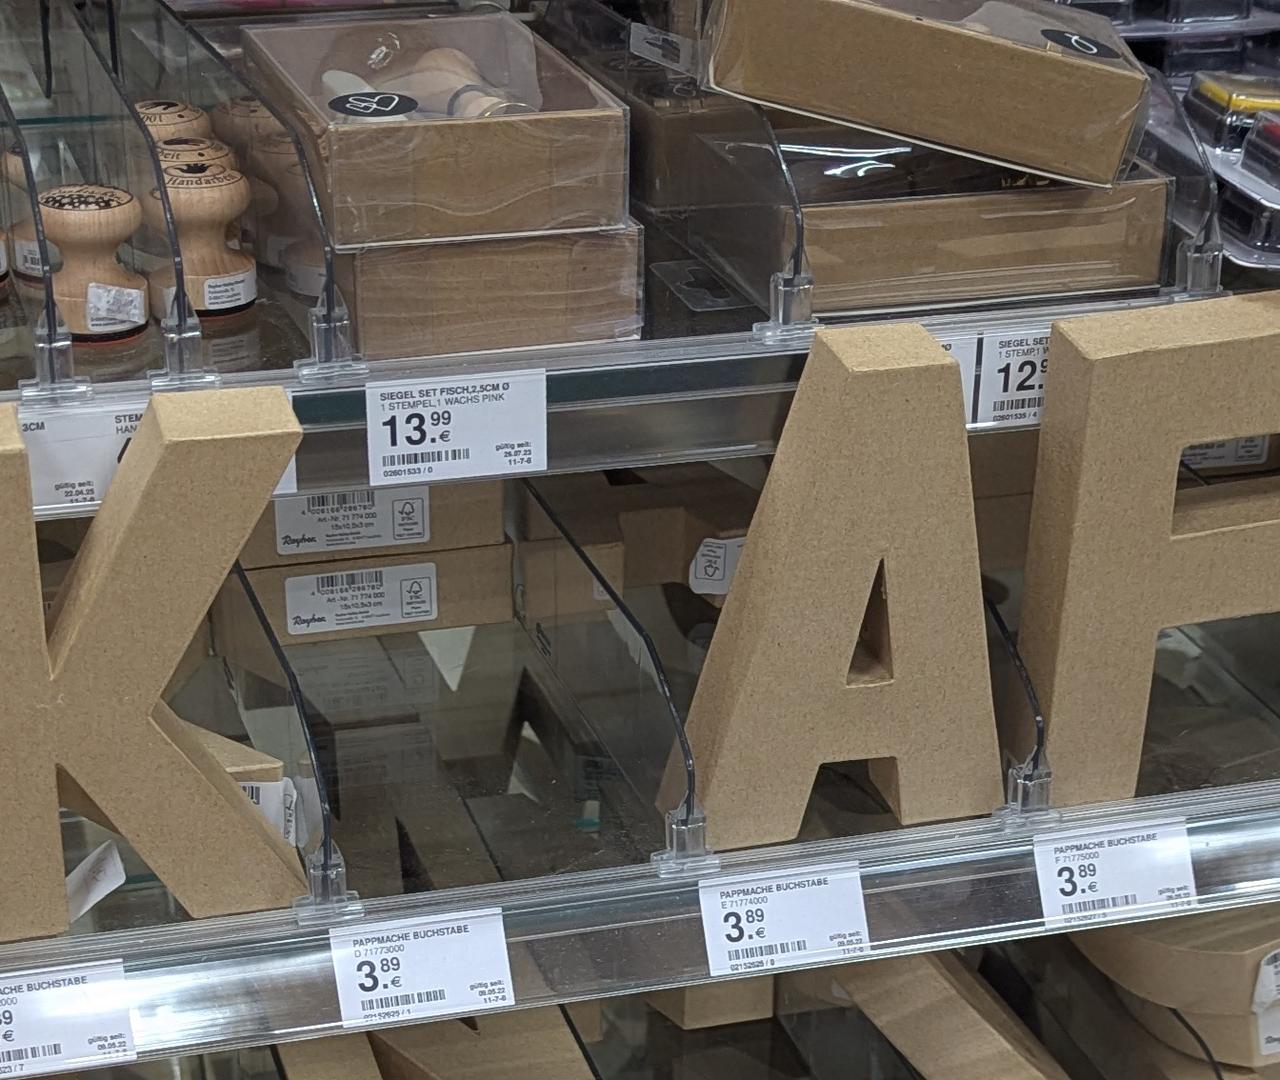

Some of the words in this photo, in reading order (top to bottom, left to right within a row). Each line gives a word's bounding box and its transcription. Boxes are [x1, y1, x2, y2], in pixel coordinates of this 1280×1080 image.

[998, 339, 1029, 349] SIEGEL
[380, 390, 416, 401] SIEGEL
[418, 388, 438, 399] SET
[444, 395, 480, 406] WACHS
[482, 392, 505, 402] PINK
[1054, 840, 1106, 855] PAPPMACHE
[1107, 832, 1158, 849] BUCHSTABE
[720, 884, 774, 900] PAPPMACHE
[776, 876, 829, 893] BUCHSTABE
[352, 932, 411, 948] PAPPMACHE
[412, 924, 470, 940] BUCHSTABE
[26, 976, 89, 993] BUCHSTABE
